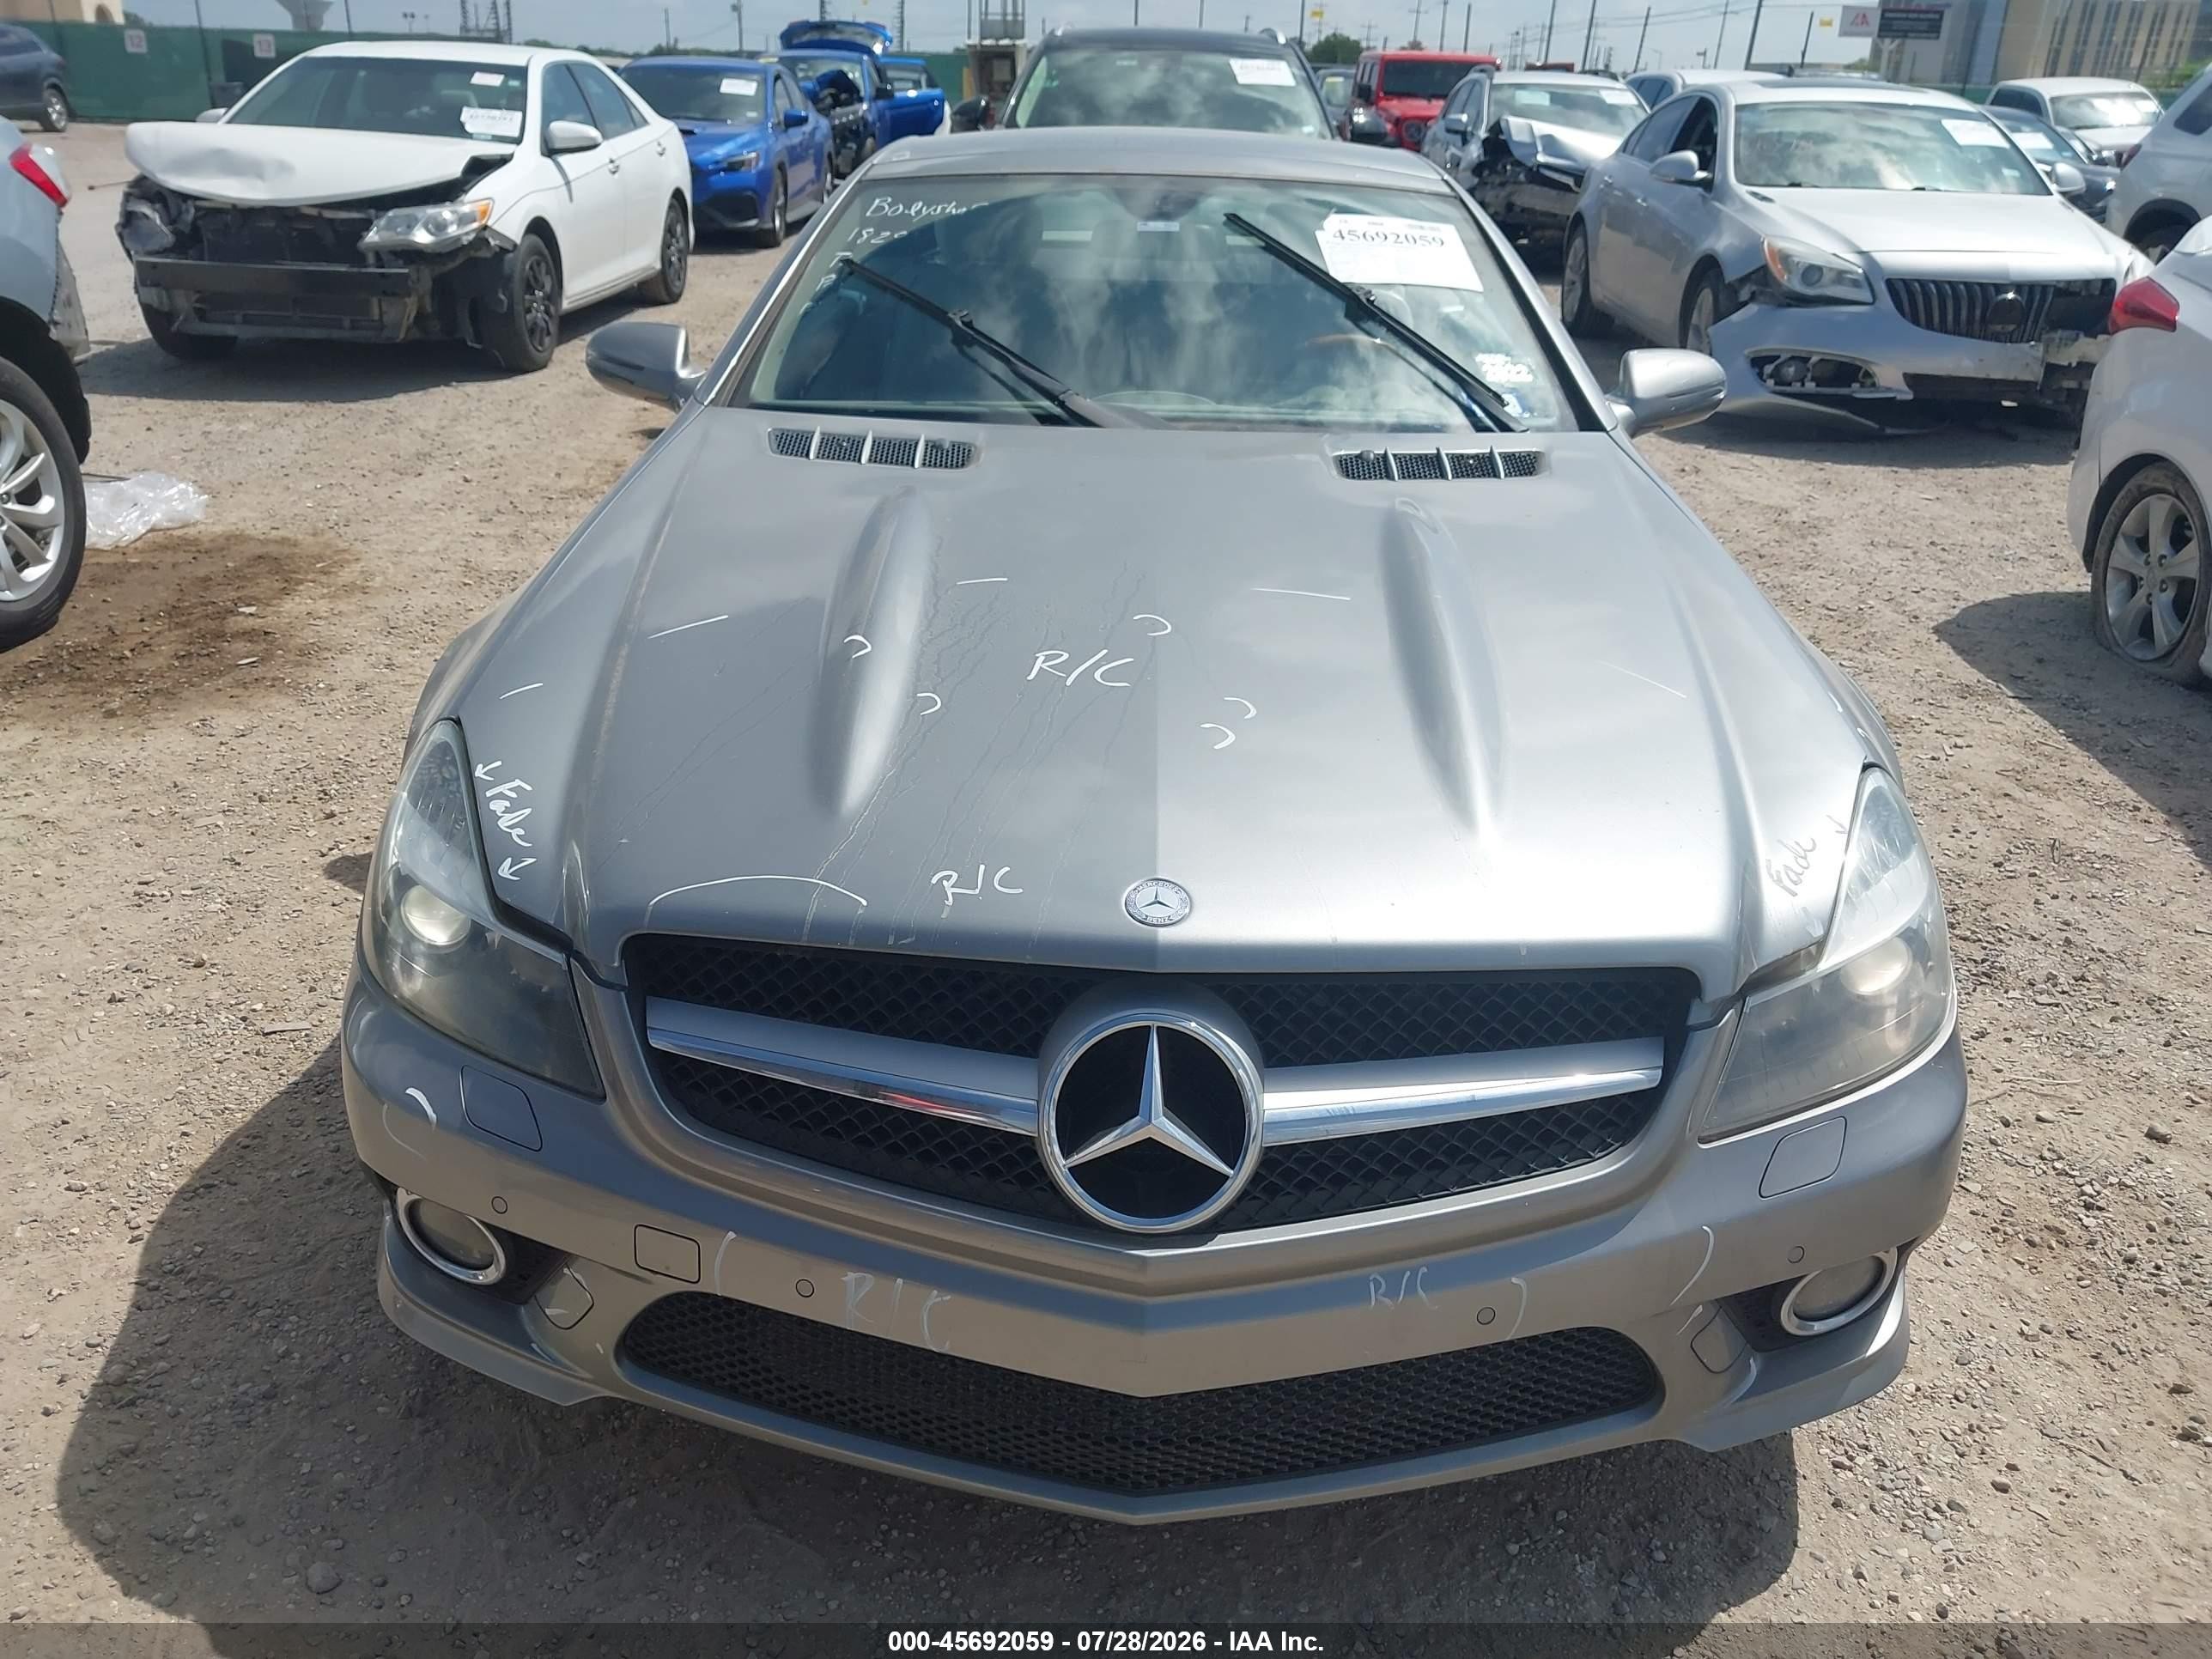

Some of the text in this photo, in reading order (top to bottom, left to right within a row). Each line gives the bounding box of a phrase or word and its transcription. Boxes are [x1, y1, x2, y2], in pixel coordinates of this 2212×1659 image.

[129, 34, 143, 49] 12
[1333, 228, 1444, 248] 45692059
[1026, 648, 1134, 687] R/C
[485, 779, 533, 847] Fade
[931, 864, 1024, 906] R/C
[1765, 837, 1817, 897] Fade
[1135, 881, 1183, 894] MERCEDES
[1146, 915, 1172, 924] BENZ
[1369, 1266, 1439, 1310] R/C
[841, 1271, 951, 1352] R/C
